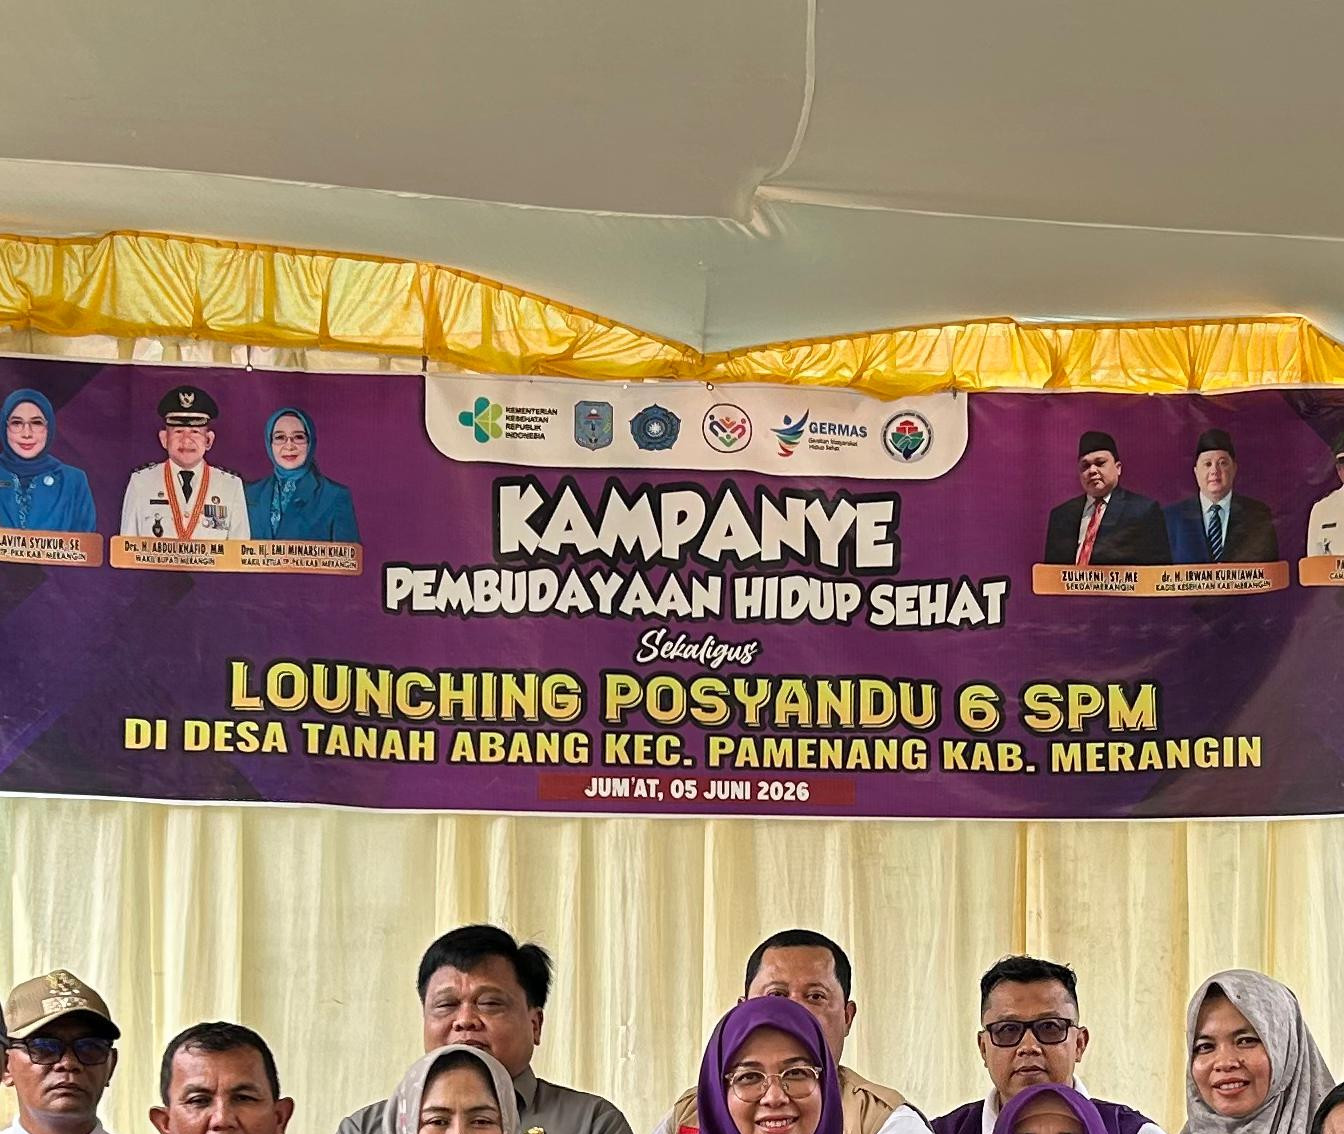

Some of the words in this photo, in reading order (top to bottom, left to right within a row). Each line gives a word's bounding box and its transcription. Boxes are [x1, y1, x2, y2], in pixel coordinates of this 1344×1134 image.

[506, 407, 558, 416] KEMENTERIAN
[506, 416, 549, 424] KESEHATAN
[809, 421, 868, 438] GERMAS
[497, 484, 895, 568] KAMPANYE
[152, 541, 177, 553] ABDUL
[210, 544, 225, 555] MM
[328, 546, 356, 558] KHAFID
[1124, 572, 1138, 582] ME
[1215, 568, 1265, 581] KURNIAWAN
[386, 567, 723, 616] PEMBUDAYAAN
[734, 574, 860, 622] HIDUP
[870, 580, 1006, 627] SEHAT
[636, 628, 758, 669] Sekaligus
[227, 661, 582, 722] LOUNCHING
[605, 674, 937, 729] POSYANDU
[959, 683, 1002, 731] 6
[1023, 683, 1158, 732] SPM
[124, 717, 167, 751] DI
[184, 719, 288, 754] DESA
[302, 724, 435, 762] TANAH
[450, 731, 590, 765] ABANG
[604, 733, 694, 767] KEC.
[708, 735, 927, 769] PAMENANG
[942, 741, 1036, 773] KAB.
[1051, 736, 1263, 773] MERANGIN
[670, 779, 698, 799] 05
[703, 780, 751, 800] JUNI
[757, 781, 810, 801] 2026
